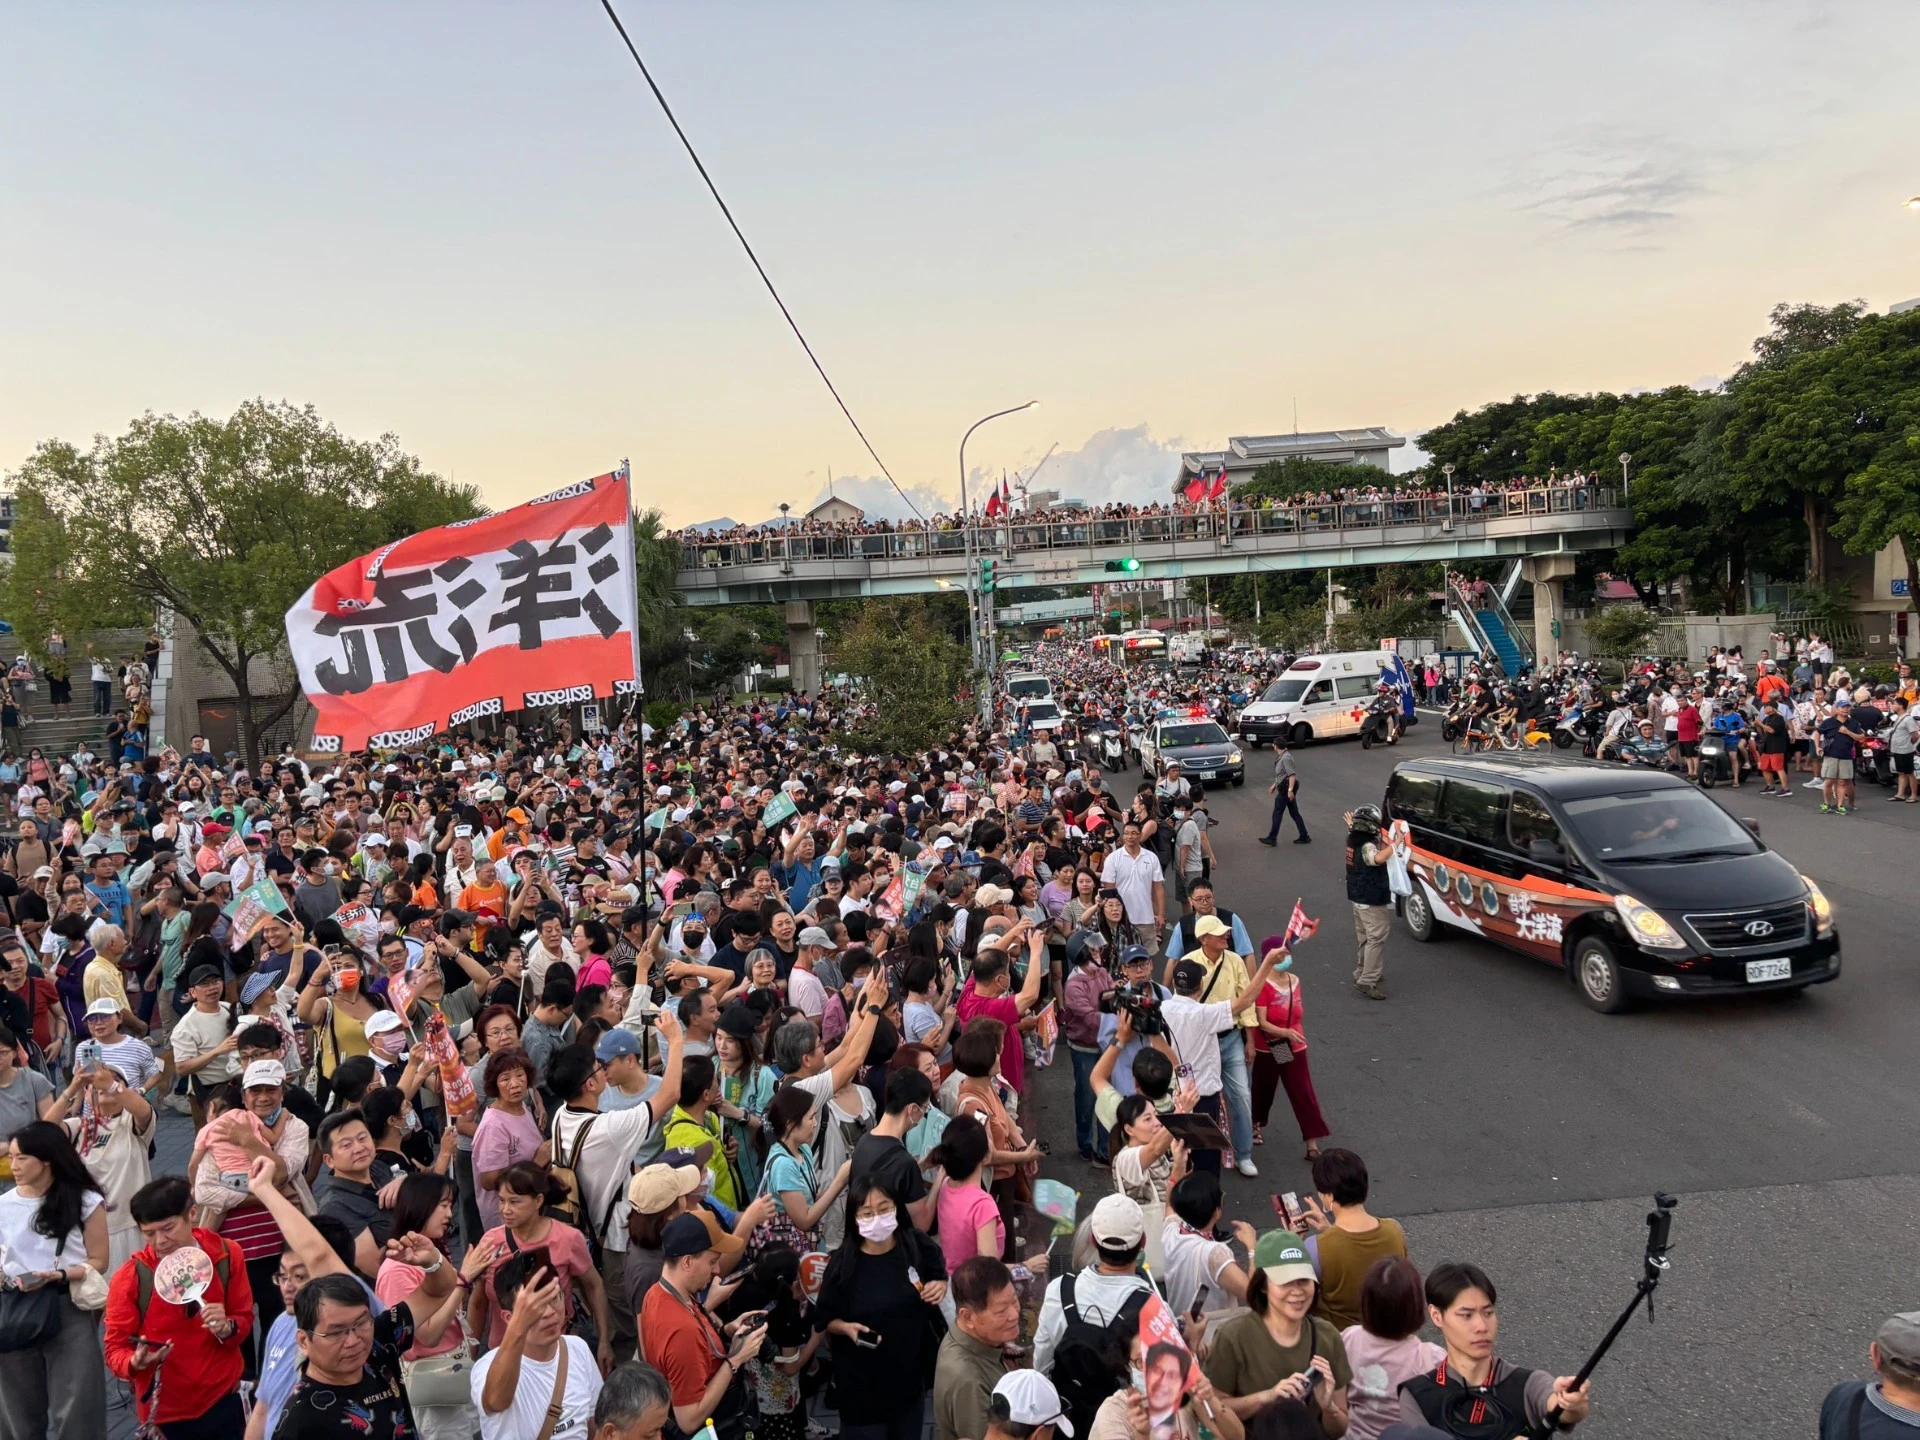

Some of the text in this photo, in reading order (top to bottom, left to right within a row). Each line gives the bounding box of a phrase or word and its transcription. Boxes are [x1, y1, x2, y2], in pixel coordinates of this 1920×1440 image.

[337, 906, 367, 924] 洋流
[1515, 912, 1564, 944] 大洋流
